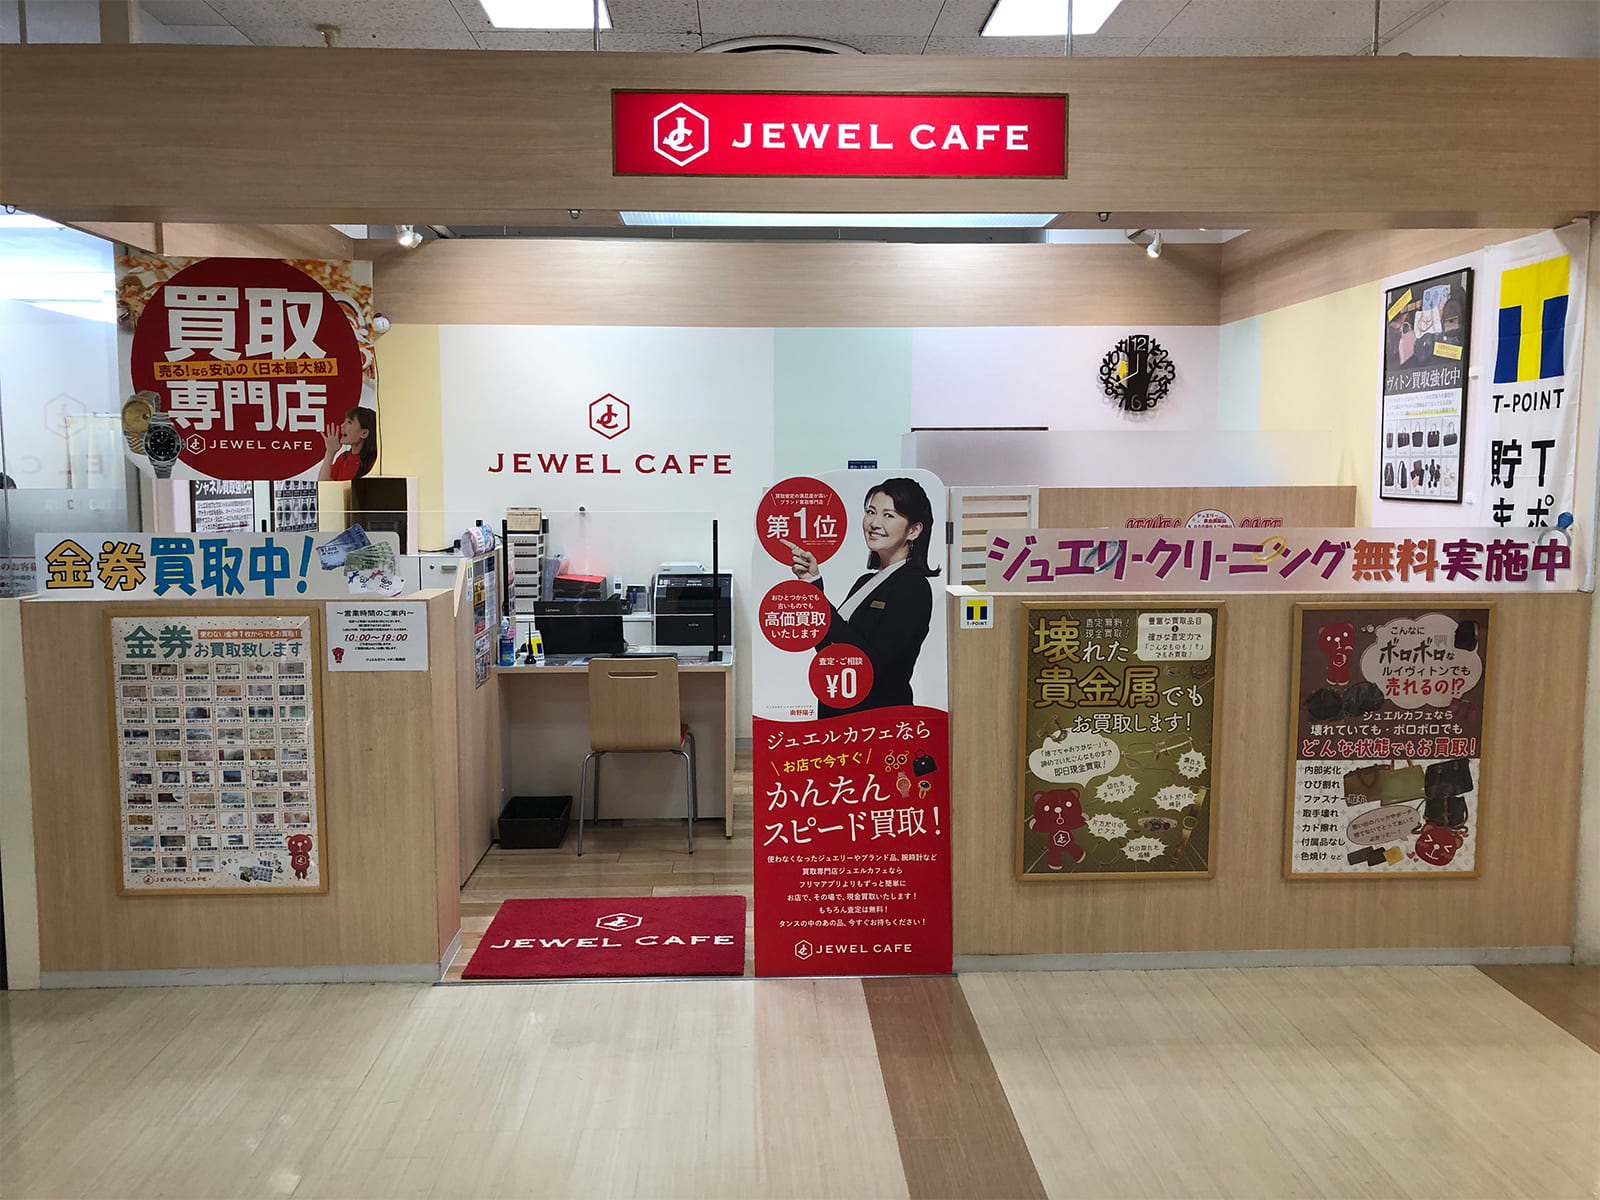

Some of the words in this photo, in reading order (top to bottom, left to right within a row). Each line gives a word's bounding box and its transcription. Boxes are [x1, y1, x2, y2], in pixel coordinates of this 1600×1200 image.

[732, 122, 893, 150] JEWEL
[909, 123, 1029, 150] CAFE
[164, 285, 328, 362] 買取
[1132, 337, 1147, 351] 12
[1386, 367, 1461, 391] ヴィトン買取強化中
[166, 380, 330, 433] 専門店
[1492, 388, 1565, 413] T-POINT
[209, 439, 266, 450] JEWEL
[271, 440, 313, 451] CAFE
[488, 453, 621, 474] JEWEL
[634, 454, 732, 475] CAFE
[766, 507, 838, 540] 第1位
[764, 611, 826, 627] 高価買取
[1148, 616, 1202, 625] 豊富な買取品目
[771, 629, 820, 639] いたします
[1086, 629, 1130, 639] 現金買取！
[1390, 626, 1425, 635] こんなに
[124, 625, 193, 659] 金券
[194, 642, 303, 658] お買取致します
[1033, 616, 1129, 663] 壊れた
[1379, 637, 1456, 664] ボロボロな
[818, 657, 863, 666] 査定・ご相談
[1382, 666, 1471, 677] ルイヴィトンでも
[825, 667, 857, 699] ¥0
[1034, 664, 1204, 709] 貴金属でも
[1362, 710, 1453, 721] ジュエルカフェなら
[1072, 712, 1192, 734] お買取します！
[1310, 724, 1463, 736] 壊れていても・ボロボロでも
[767, 720, 931, 750] ジュエルカフェなら
[1301, 737, 1477, 758] どんな状態でもお買取！
[783, 752, 863, 774] お店で今すぐ
[1054, 760, 1106, 777] 即日現金買取！
[1304, 766, 1342, 775] 内部劣化
[1304, 780, 1340, 789] ひび割れ
[766, 774, 891, 812] かんたん
[1302, 809, 1338, 818] 取手壊れ
[763, 806, 941, 847] スピード買取！
[1301, 824, 1338, 832] カド擦れ
[1301, 838, 1346, 847] 付属品なし
[1300, 852, 1327, 861] 色焼け
[802, 867, 903, 876] 買取専門店ジュエルカフェなら
[799, 880, 907, 888] フリマアプリよりもずっと簡単に
[819, 906, 888, 914] もちろん査定は無料！
[490, 937, 622, 949] JEWEL
[635, 935, 735, 946] CAFE
[816, 944, 868, 954] JEWEL
[873, 943, 913, 954] CAFE
